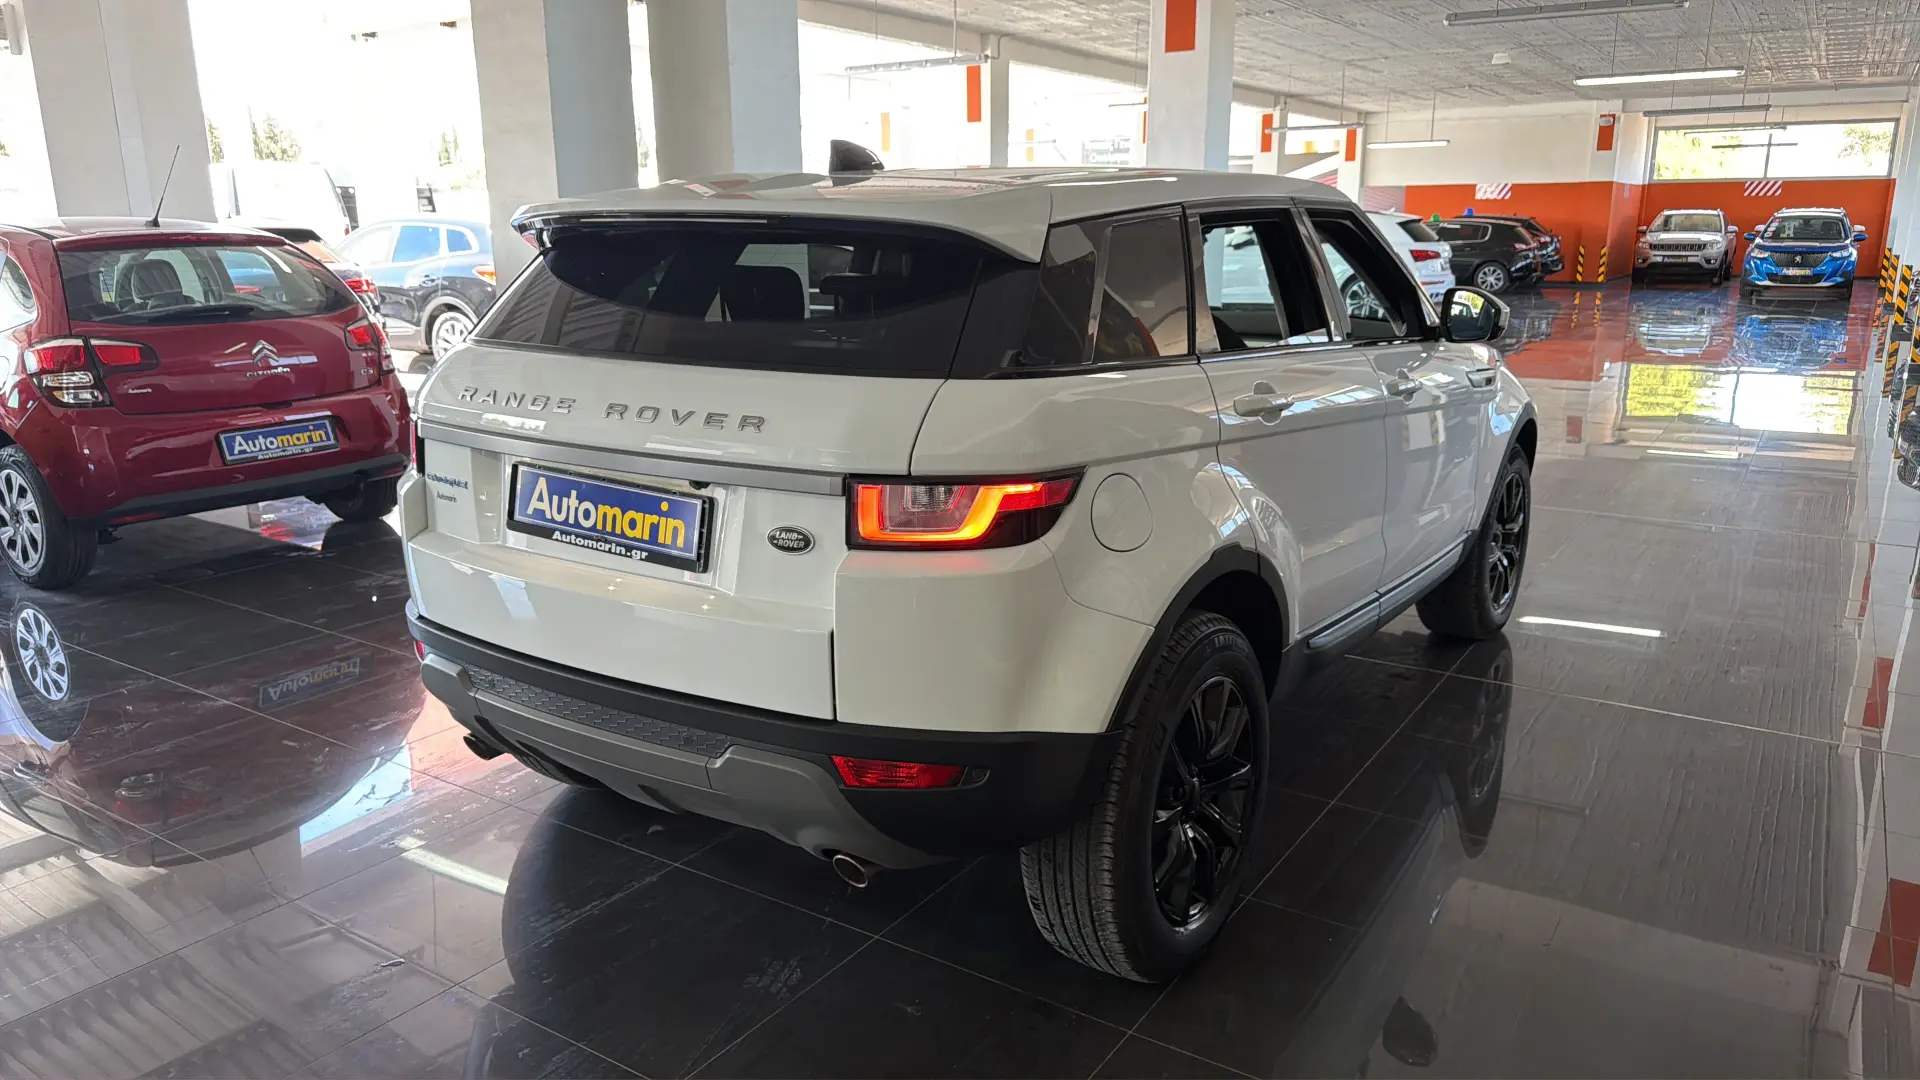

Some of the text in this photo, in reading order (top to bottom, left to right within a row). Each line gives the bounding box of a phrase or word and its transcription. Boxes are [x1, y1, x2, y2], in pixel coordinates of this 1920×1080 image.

[458, 386, 766, 433] RANGE ROVER
[233, 425, 327, 454] Automarin
[257, 447, 313, 459] Automarin.gr
[527, 476, 686, 548] Automarin
[552, 530, 648, 561] Automarin.gr
[776, 531, 797, 540] LAND
[777, 539, 805, 548] ROVER
